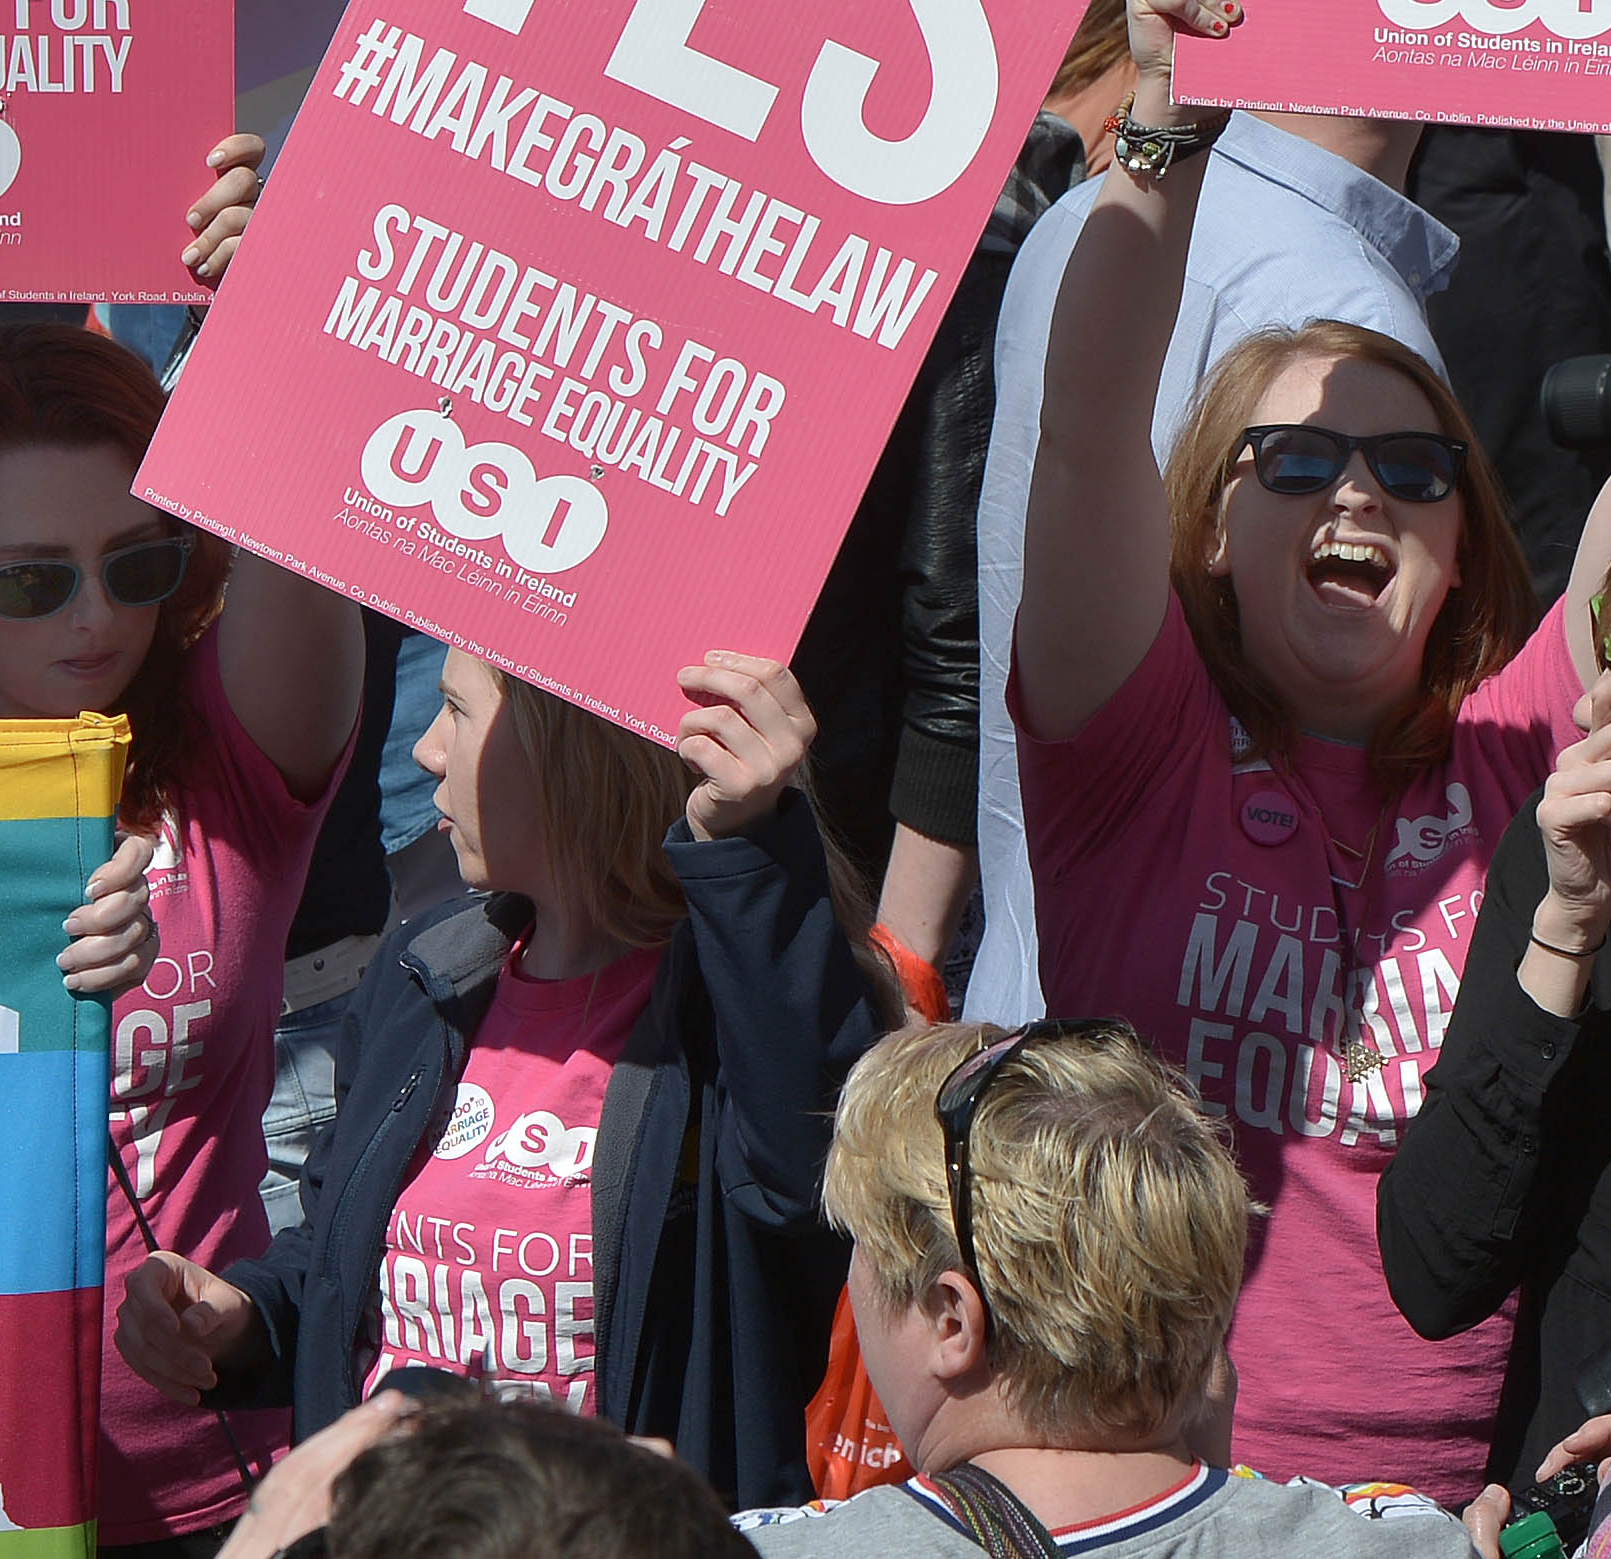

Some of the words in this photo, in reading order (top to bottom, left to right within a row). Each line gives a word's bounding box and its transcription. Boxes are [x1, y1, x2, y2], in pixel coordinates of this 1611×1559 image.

[1372, 45, 1435, 65] Aontas
[1439, 52, 1462, 67] na
[1467, 52, 1506, 70] Mac
[1511, 54, 1559, 73] Léinn
[1563, 57, 1580, 74] in
[1373, 27, 1428, 46] Union
[1434, 30, 1453, 48] of
[1457, 32, 1541, 53] Students
[1545, 37, 1563, 54] in
[1341, 105, 1367, 117] Park
[1476, 113, 1530, 128] Published
[1568, 118, 1599, 132] Union
[332, 19, 938, 351] #MAKEGRÁTHELAW
[9, 290, 55, 301] Students
[111, 291, 136, 302] York
[172, 292, 205, 303] Dublin
[355, 203, 663, 398] STUDENTS
[659, 339, 787, 458] FOR
[322, 276, 554, 427] MARRIAGE
[540, 378, 759, 518] EQUALITY
[389, 423, 572, 548] USI
[333, 507, 393, 544] Aontas
[392, 536, 417, 556] na
[417, 546, 456, 574] Mac
[456, 563, 503, 593] Léinn
[503, 585, 522, 605] in
[521, 593, 569, 627] Éirinn
[343, 487, 393, 522] Union
[395, 515, 416, 532] of
[416, 522, 494, 569] Students
[495, 559, 514, 578] in
[515, 568, 578, 608] Ireland
[144, 487, 179, 512] Printed
[179, 504, 193, 519] by
[239, 532, 284, 561] Newtown
[284, 553, 308, 573] Park
[405, 610, 454, 641] Published
[453, 632, 467, 648] by
[467, 640, 484, 657] the
[485, 647, 515, 670] Union
[516, 662, 529, 676] of
[527, 667, 573, 698] Students
[573, 688, 585, 703] in
[624, 711, 647, 732] York
[648, 724, 677, 746] Road
[1247, 805, 1294, 828] VOTE!
[492, 1227, 594, 1277] FOR
